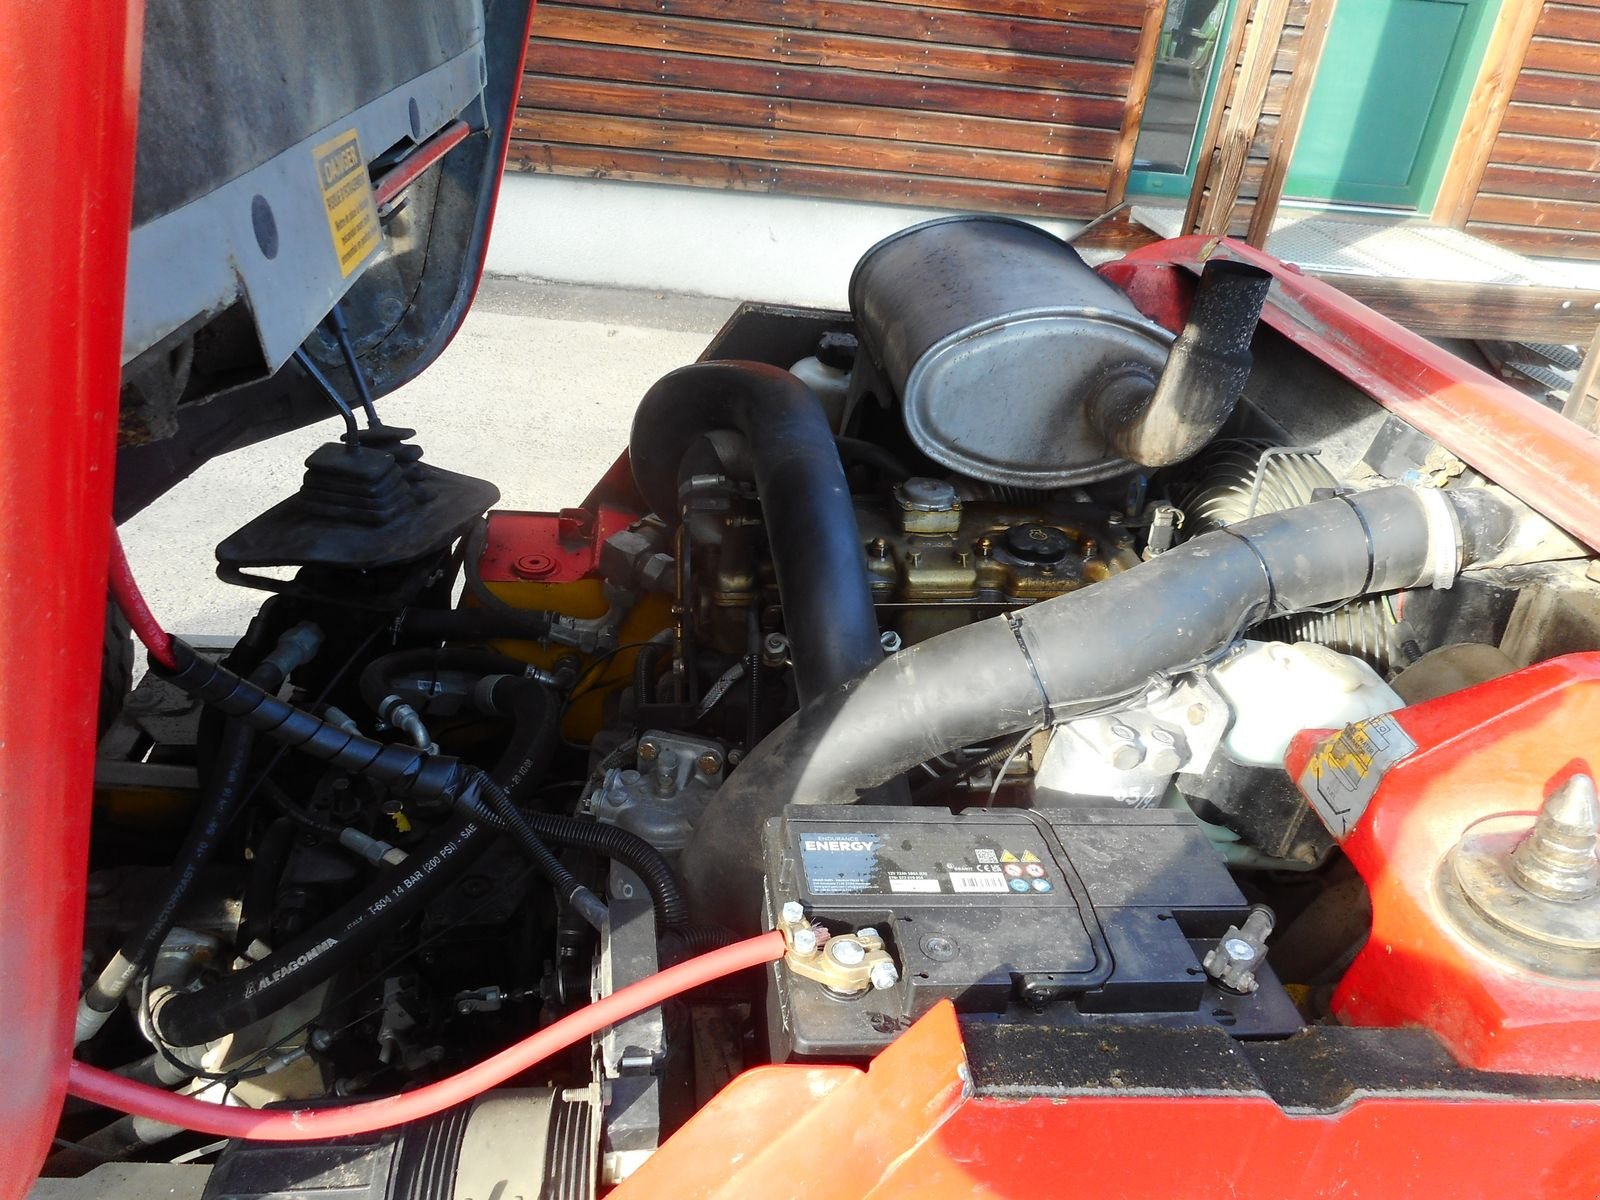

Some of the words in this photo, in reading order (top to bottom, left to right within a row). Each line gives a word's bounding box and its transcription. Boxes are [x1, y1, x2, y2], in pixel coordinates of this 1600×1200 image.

[324, 145, 359, 182] DANGER
[805, 841, 874, 851] ENERGY
[257, 937, 339, 992] ALFAGOMMA
[392, 885, 405, 898] 14
[403, 869, 425, 889] BAR
[423, 856, 442, 874] (200
[440, 842, 457, 859] PSI)
[460, 822, 479, 841] SAE
